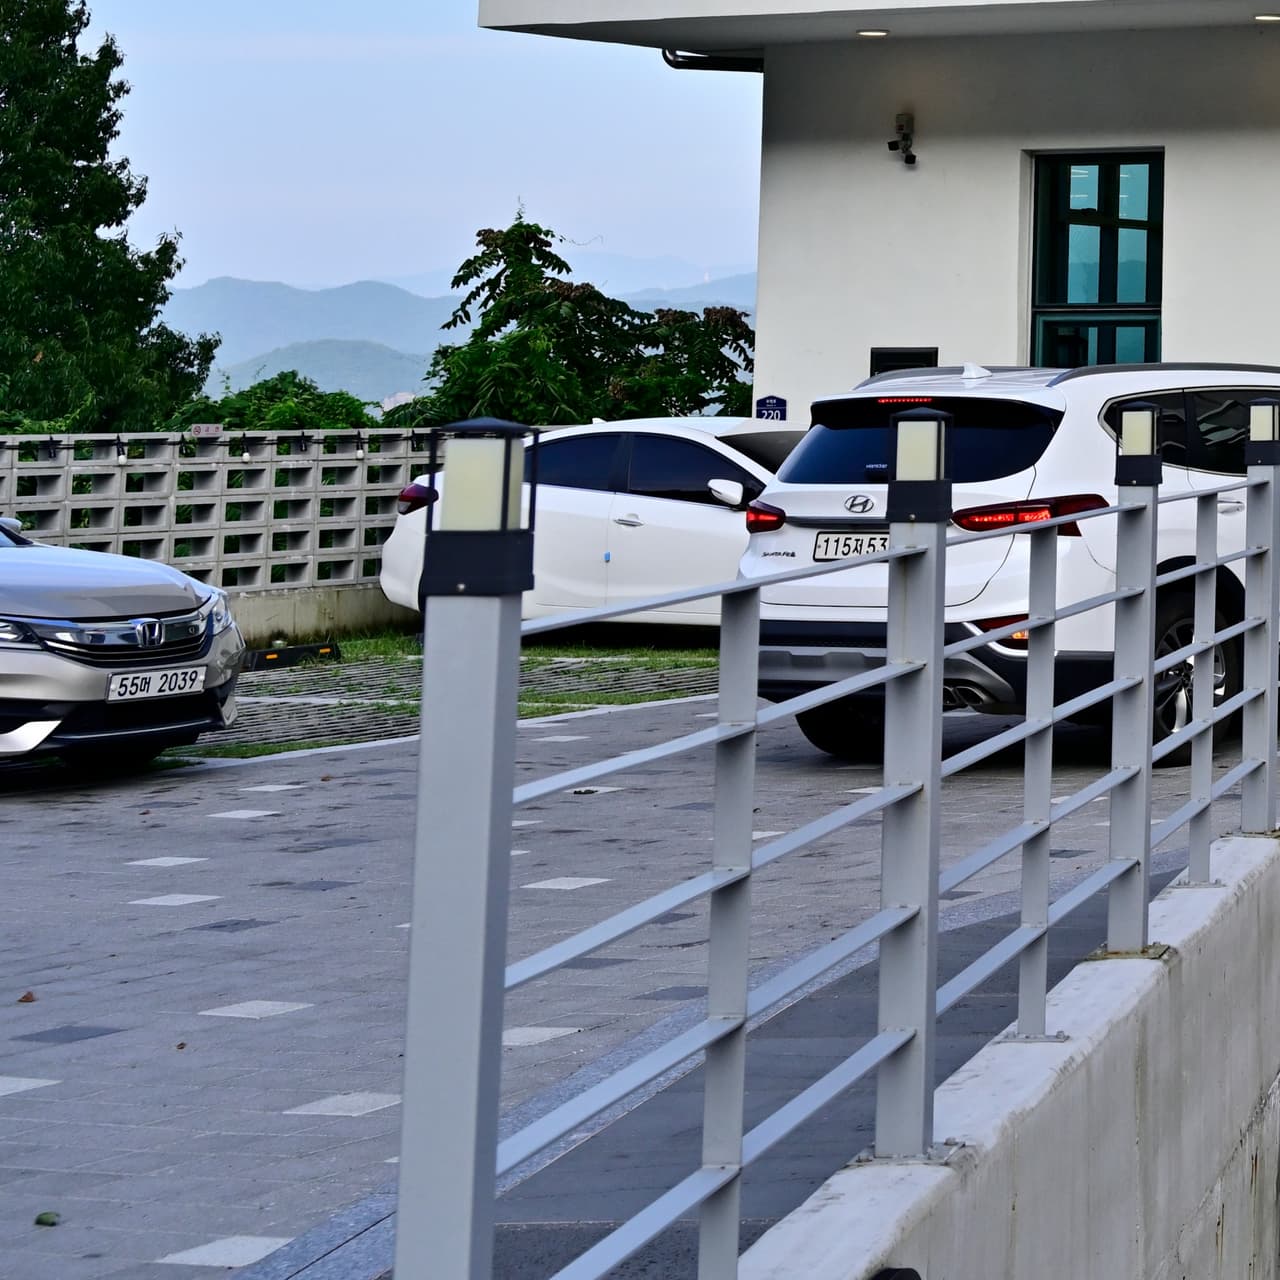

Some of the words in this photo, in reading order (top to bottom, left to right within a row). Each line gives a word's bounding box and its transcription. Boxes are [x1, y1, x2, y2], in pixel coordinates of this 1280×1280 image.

[761, 409, 781, 420] 220
[117, 675, 151, 697] 55머
[157, 670, 198, 694] 2039
